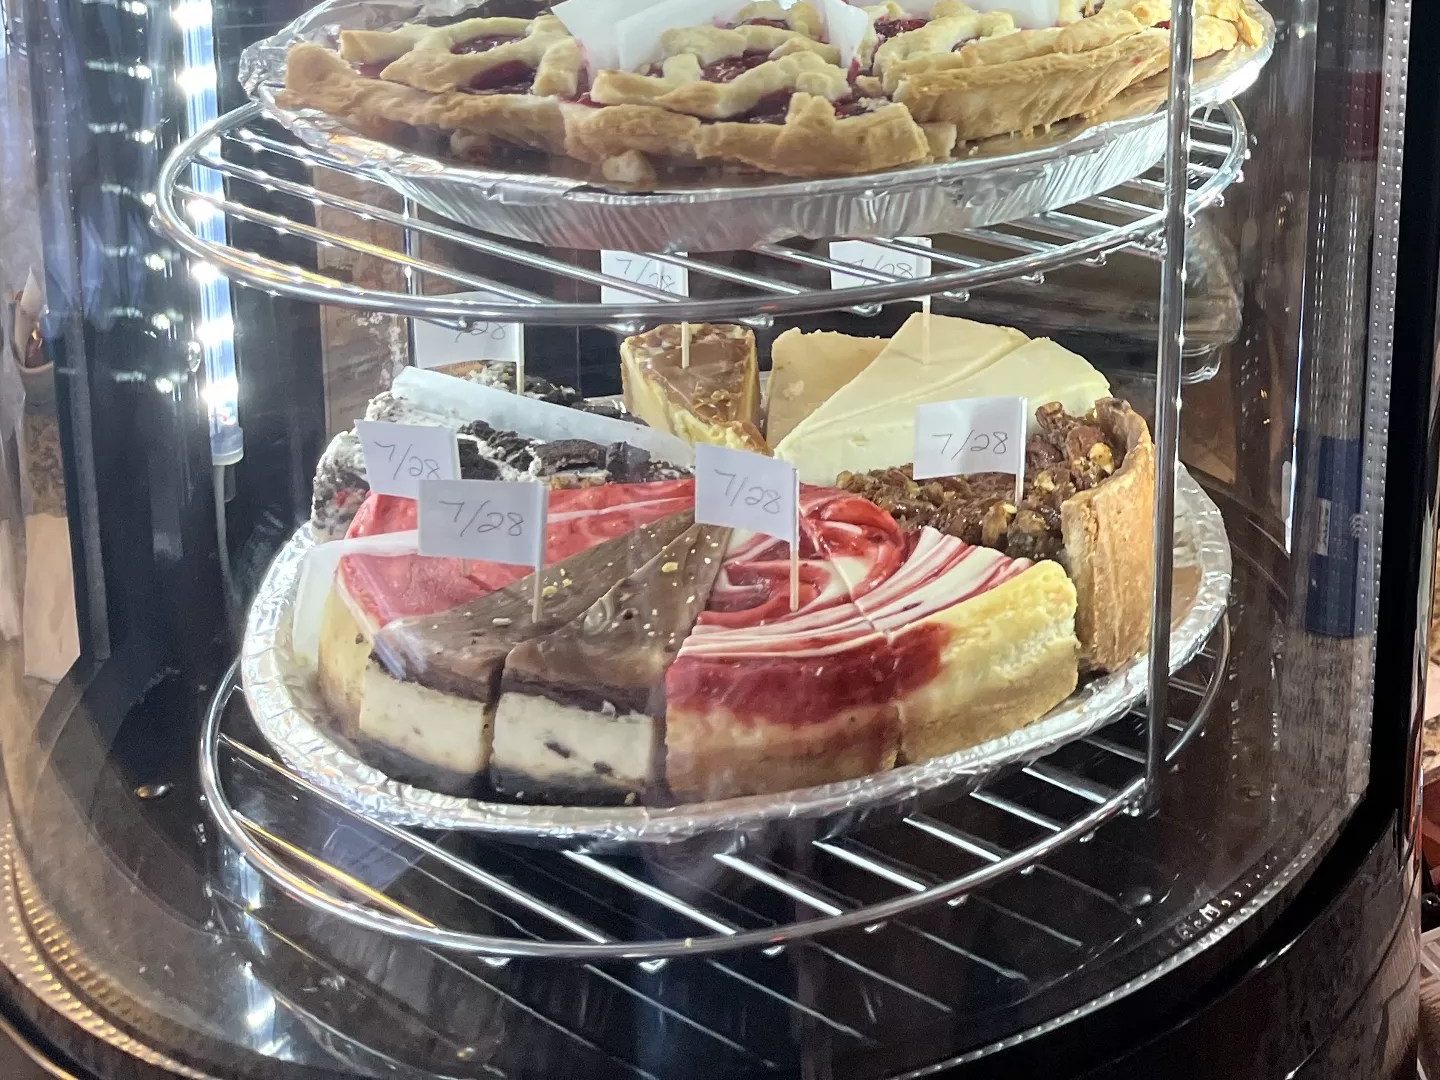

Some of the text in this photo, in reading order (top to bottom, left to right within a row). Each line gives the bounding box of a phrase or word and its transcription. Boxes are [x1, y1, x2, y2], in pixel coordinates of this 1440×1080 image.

[373, 441, 440, 482] 7/28
[930, 429, 1008, 462] 7/28
[714, 468, 781, 515] 7/28
[438, 499, 525, 538] 7/28
